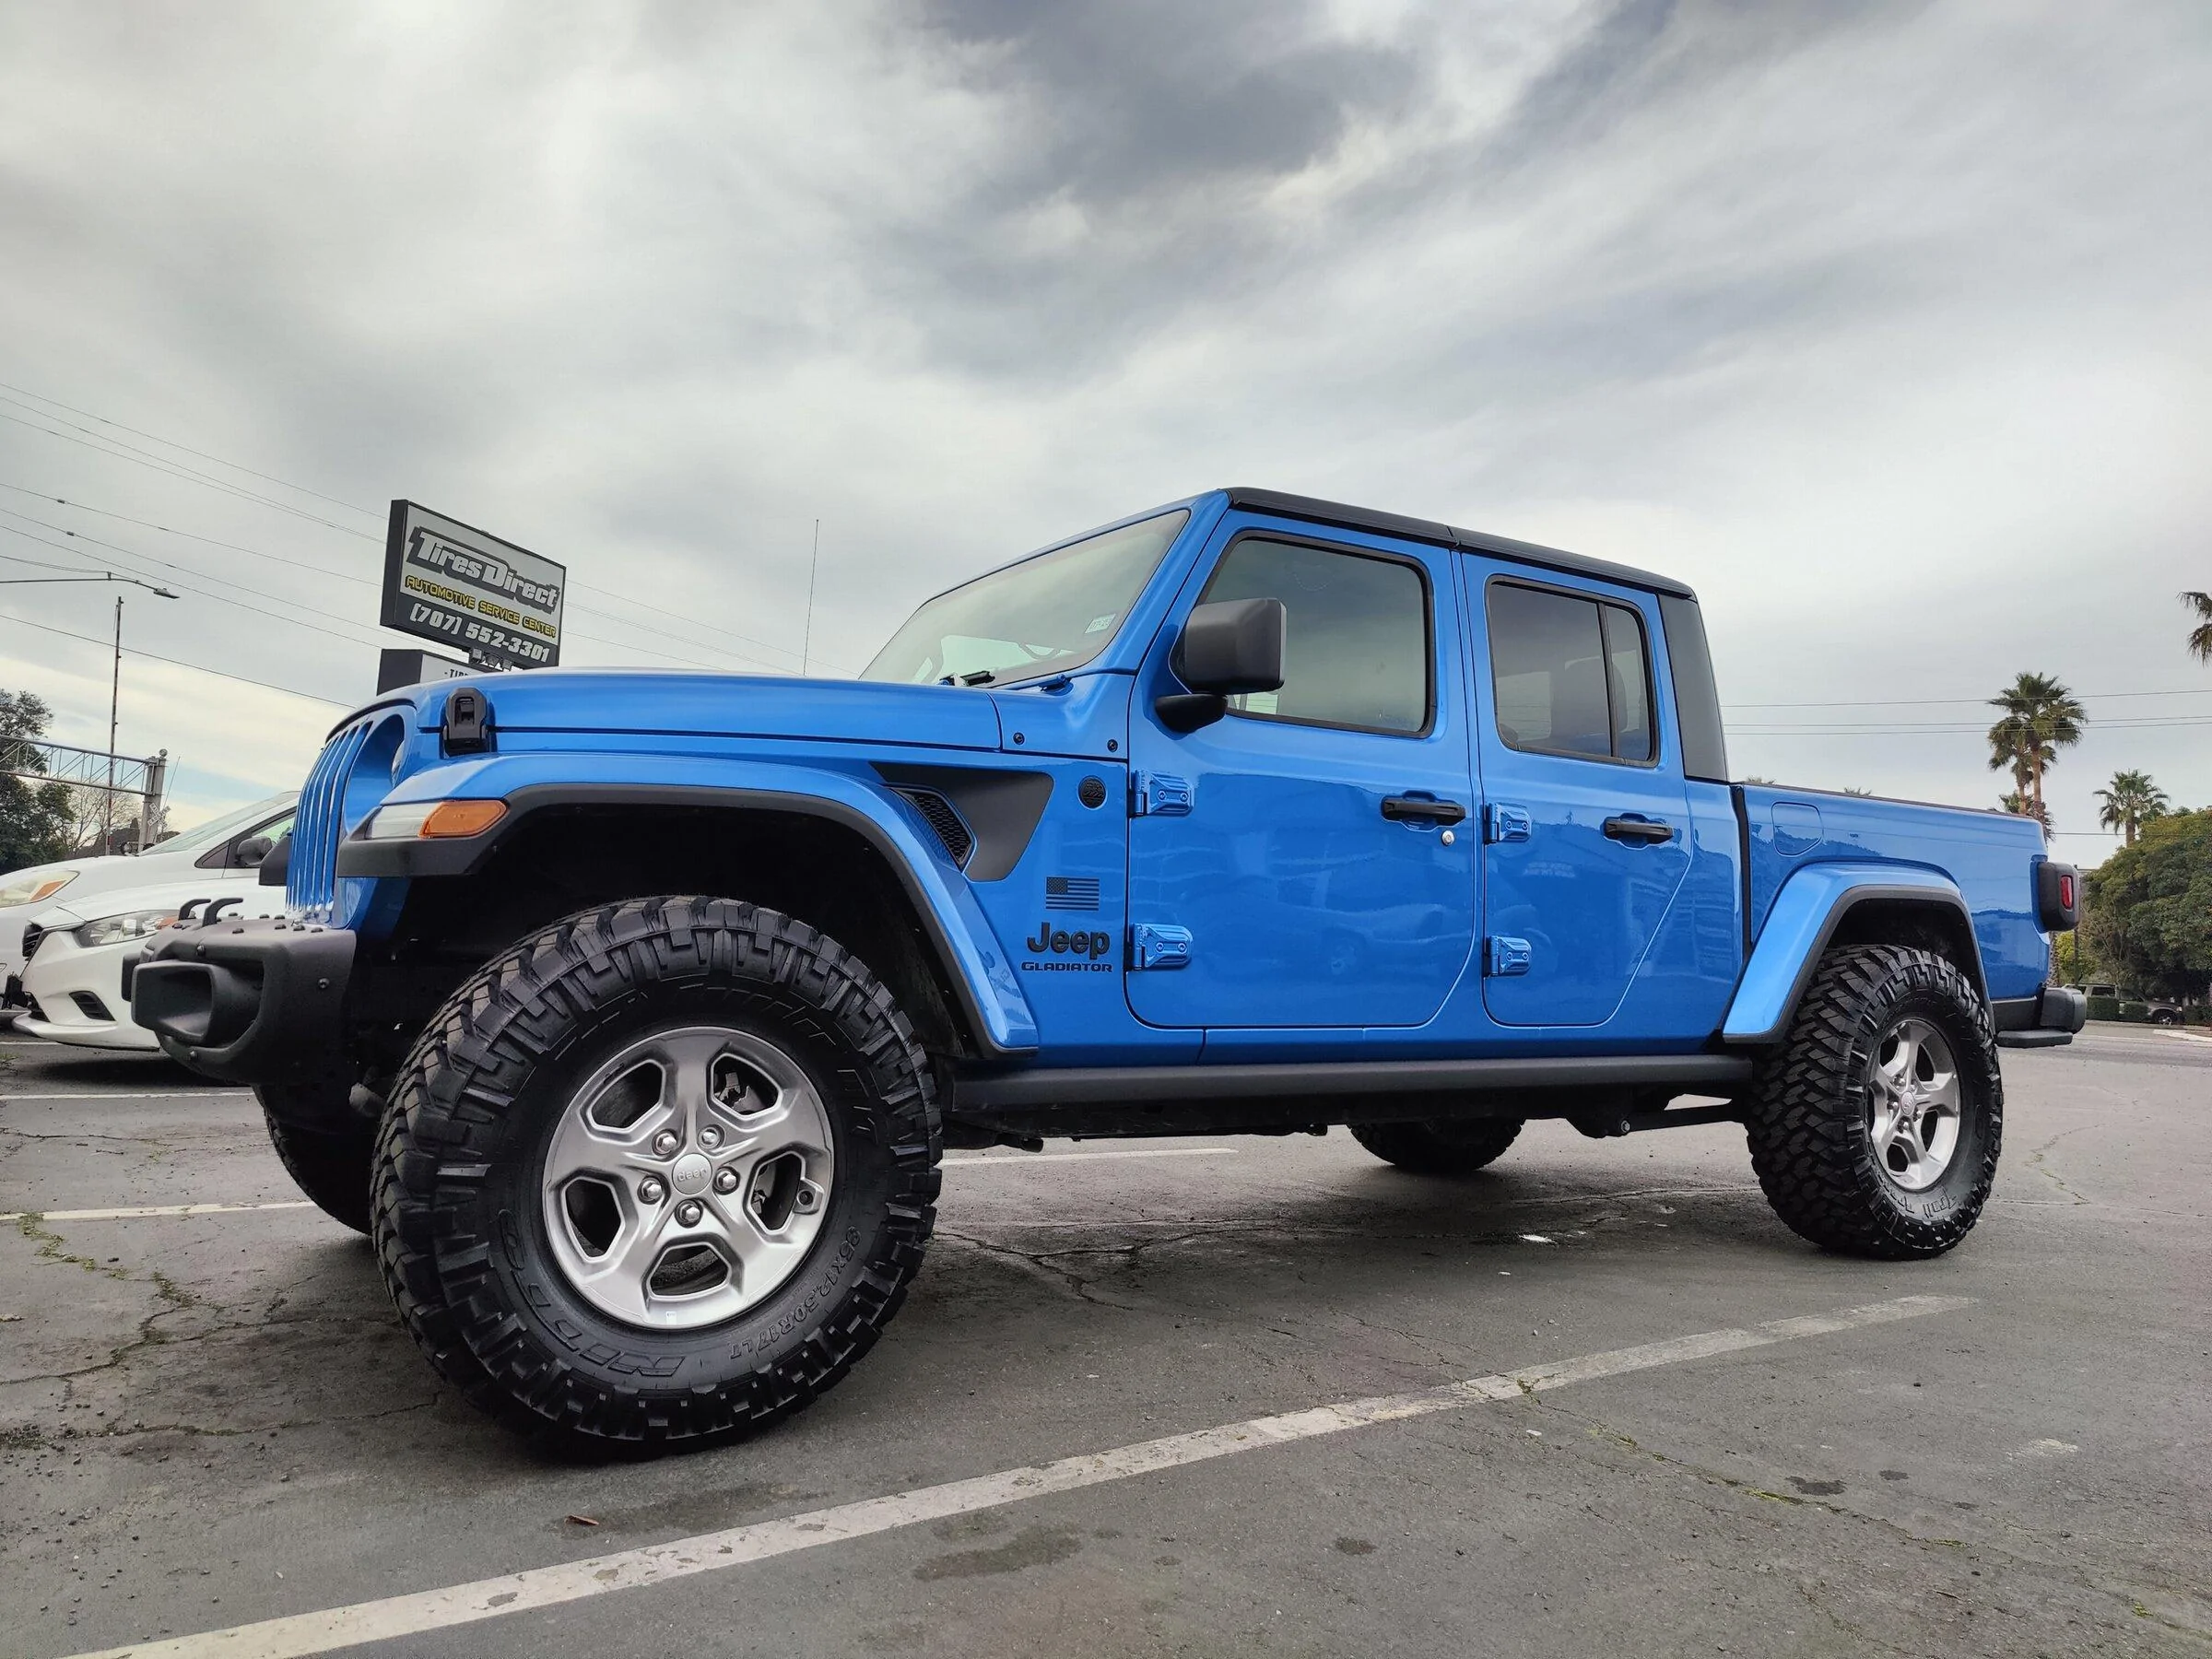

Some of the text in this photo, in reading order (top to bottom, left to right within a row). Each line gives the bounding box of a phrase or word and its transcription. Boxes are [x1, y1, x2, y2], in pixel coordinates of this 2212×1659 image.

[406, 575, 557, 639] AUTOMOTIVE SERVICE CENTER
[409, 603, 550, 663] (707) 552-3301
[1027, 922, 1111, 960] Jeep
[1021, 961, 1113, 973] GLADIATOR
